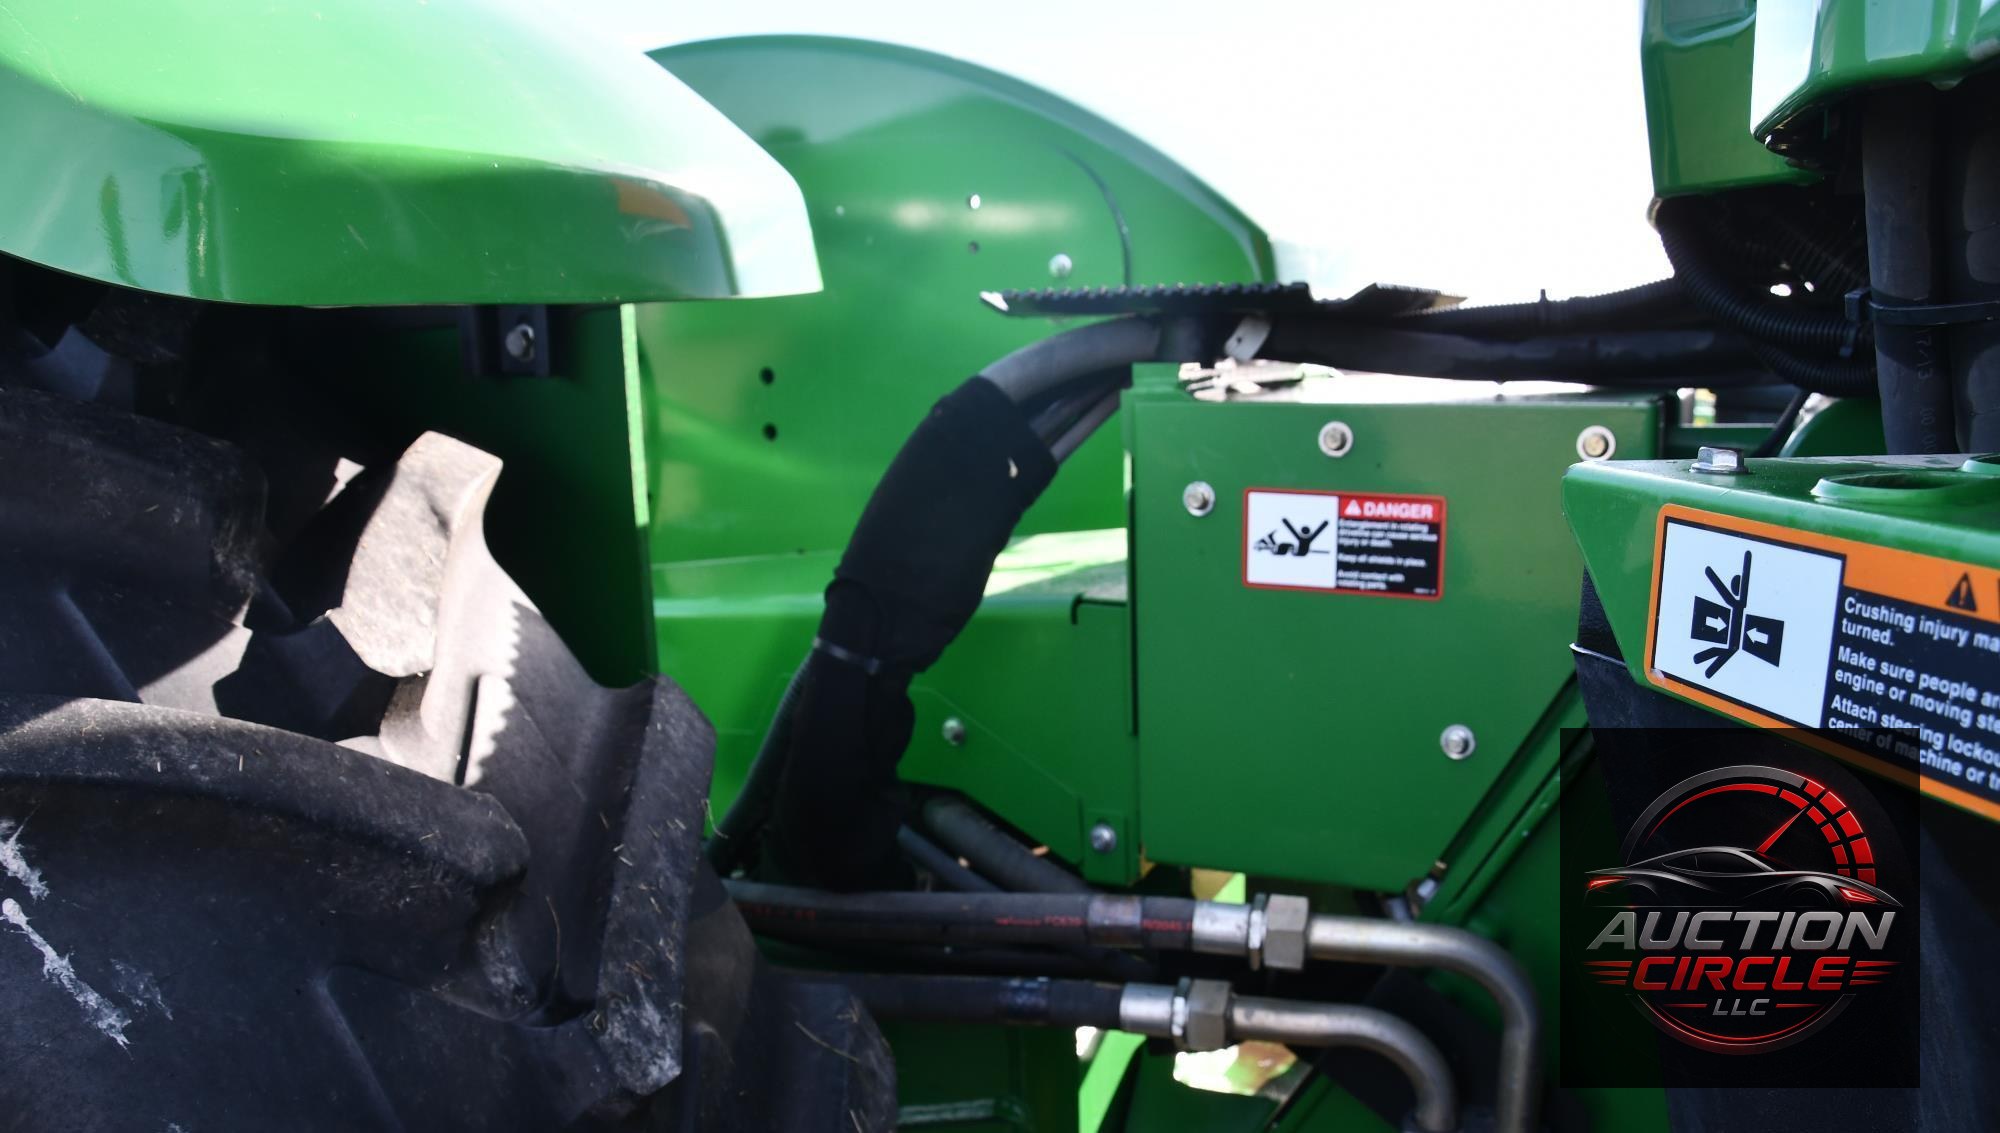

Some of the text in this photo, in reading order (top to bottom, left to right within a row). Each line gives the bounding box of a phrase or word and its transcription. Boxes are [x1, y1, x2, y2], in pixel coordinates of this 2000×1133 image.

[1363, 501, 1434, 519] DANGER
[1842, 618, 1895, 646] turned.
[1844, 596, 1915, 633] Crushing
[1919, 615, 1970, 647] injury
[1835, 669, 1885, 695] engine
[1889, 686, 1907, 702] or
[1910, 692, 1973, 728] moving
[1838, 645, 1876, 671] Make
[1880, 661, 1915, 684] sure
[1918, 673, 1977, 702] people
[1831, 694, 1877, 724] Attach
[1880, 714, 1945, 750] steering
[1829, 717, 1873, 742] center
[1876, 734, 1892, 749] of
[1895, 741, 1963, 776] machine
[1966, 766, 1986, 786] or
